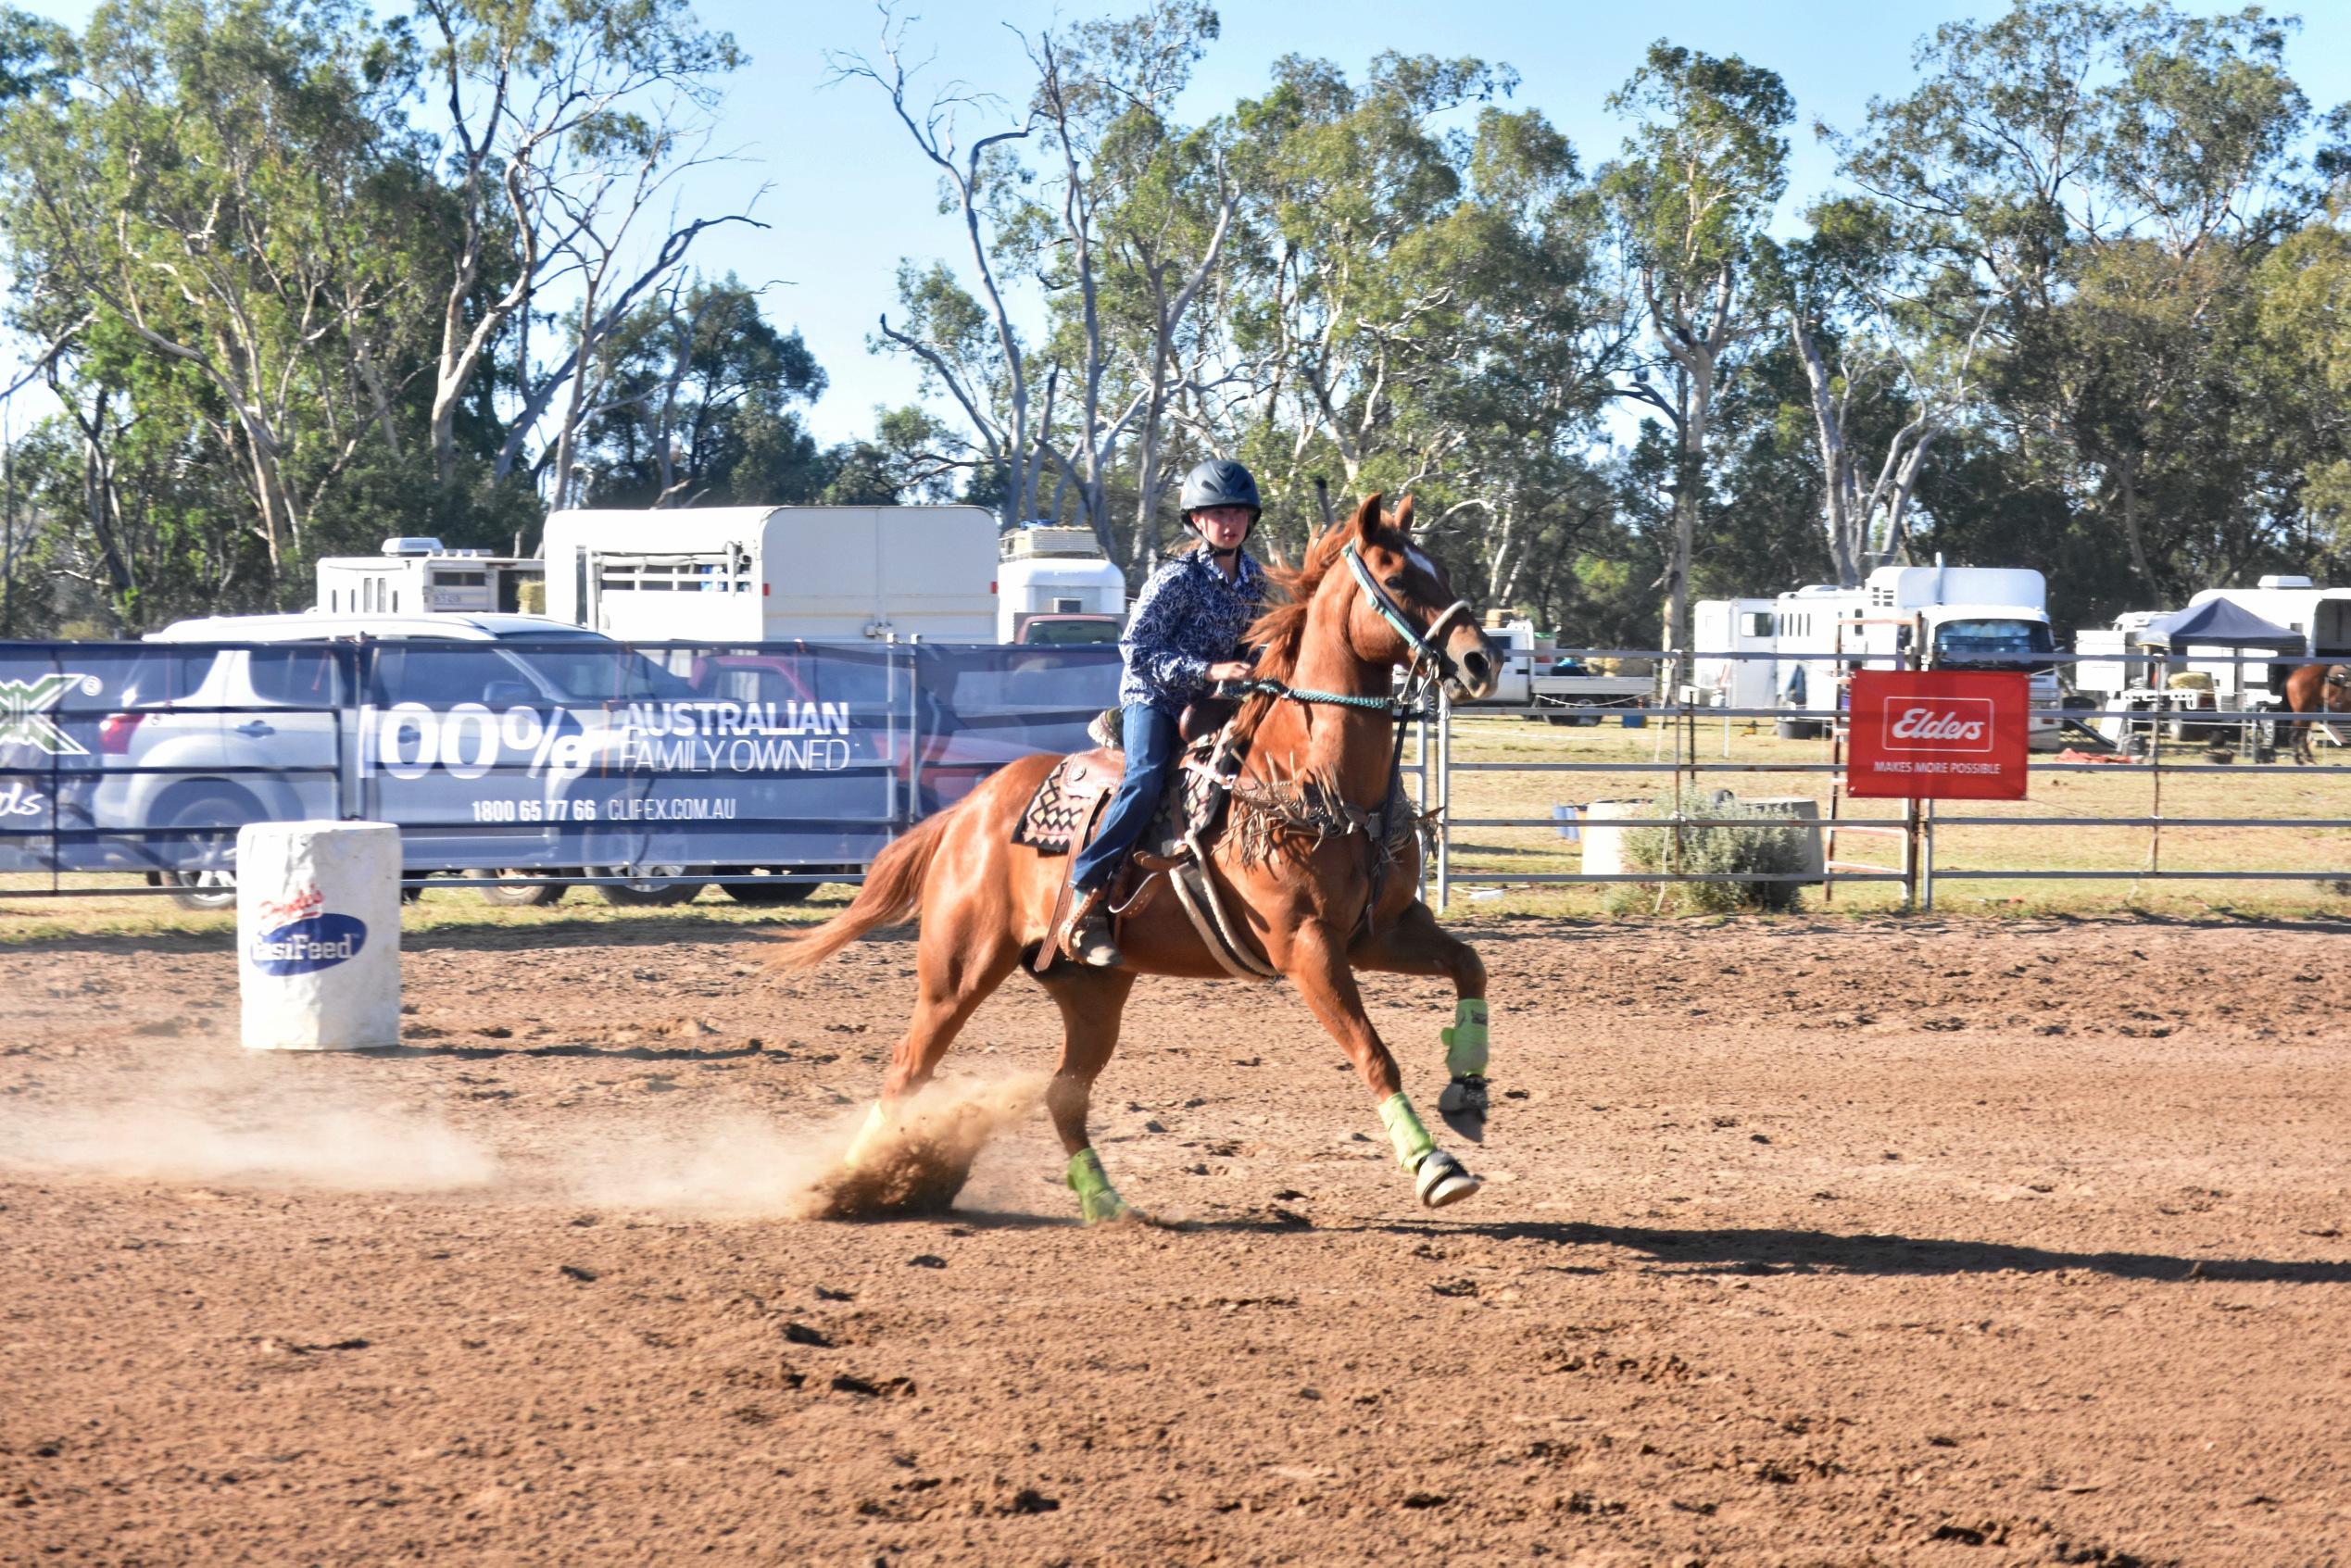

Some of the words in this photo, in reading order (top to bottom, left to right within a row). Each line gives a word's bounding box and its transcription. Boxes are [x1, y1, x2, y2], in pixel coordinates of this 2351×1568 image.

[622, 701, 850, 737] AUSTRALIAN
[1892, 708, 1985, 740] Elders
[358, 701, 592, 780] 100%
[618, 739, 725, 772] FAMILY
[729, 738, 850, 772] OWNED
[1873, 760, 1913, 773] MAKES
[1914, 761, 1949, 773] MORE
[1950, 762, 2002, 774] POSSIBLE
[472, 800, 516, 822] 1800
[519, 800, 542, 822] 65
[546, 800, 569, 822] 77
[572, 799, 597, 822] 66
[607, 798, 736, 821] CLIPEX.COM.AU
